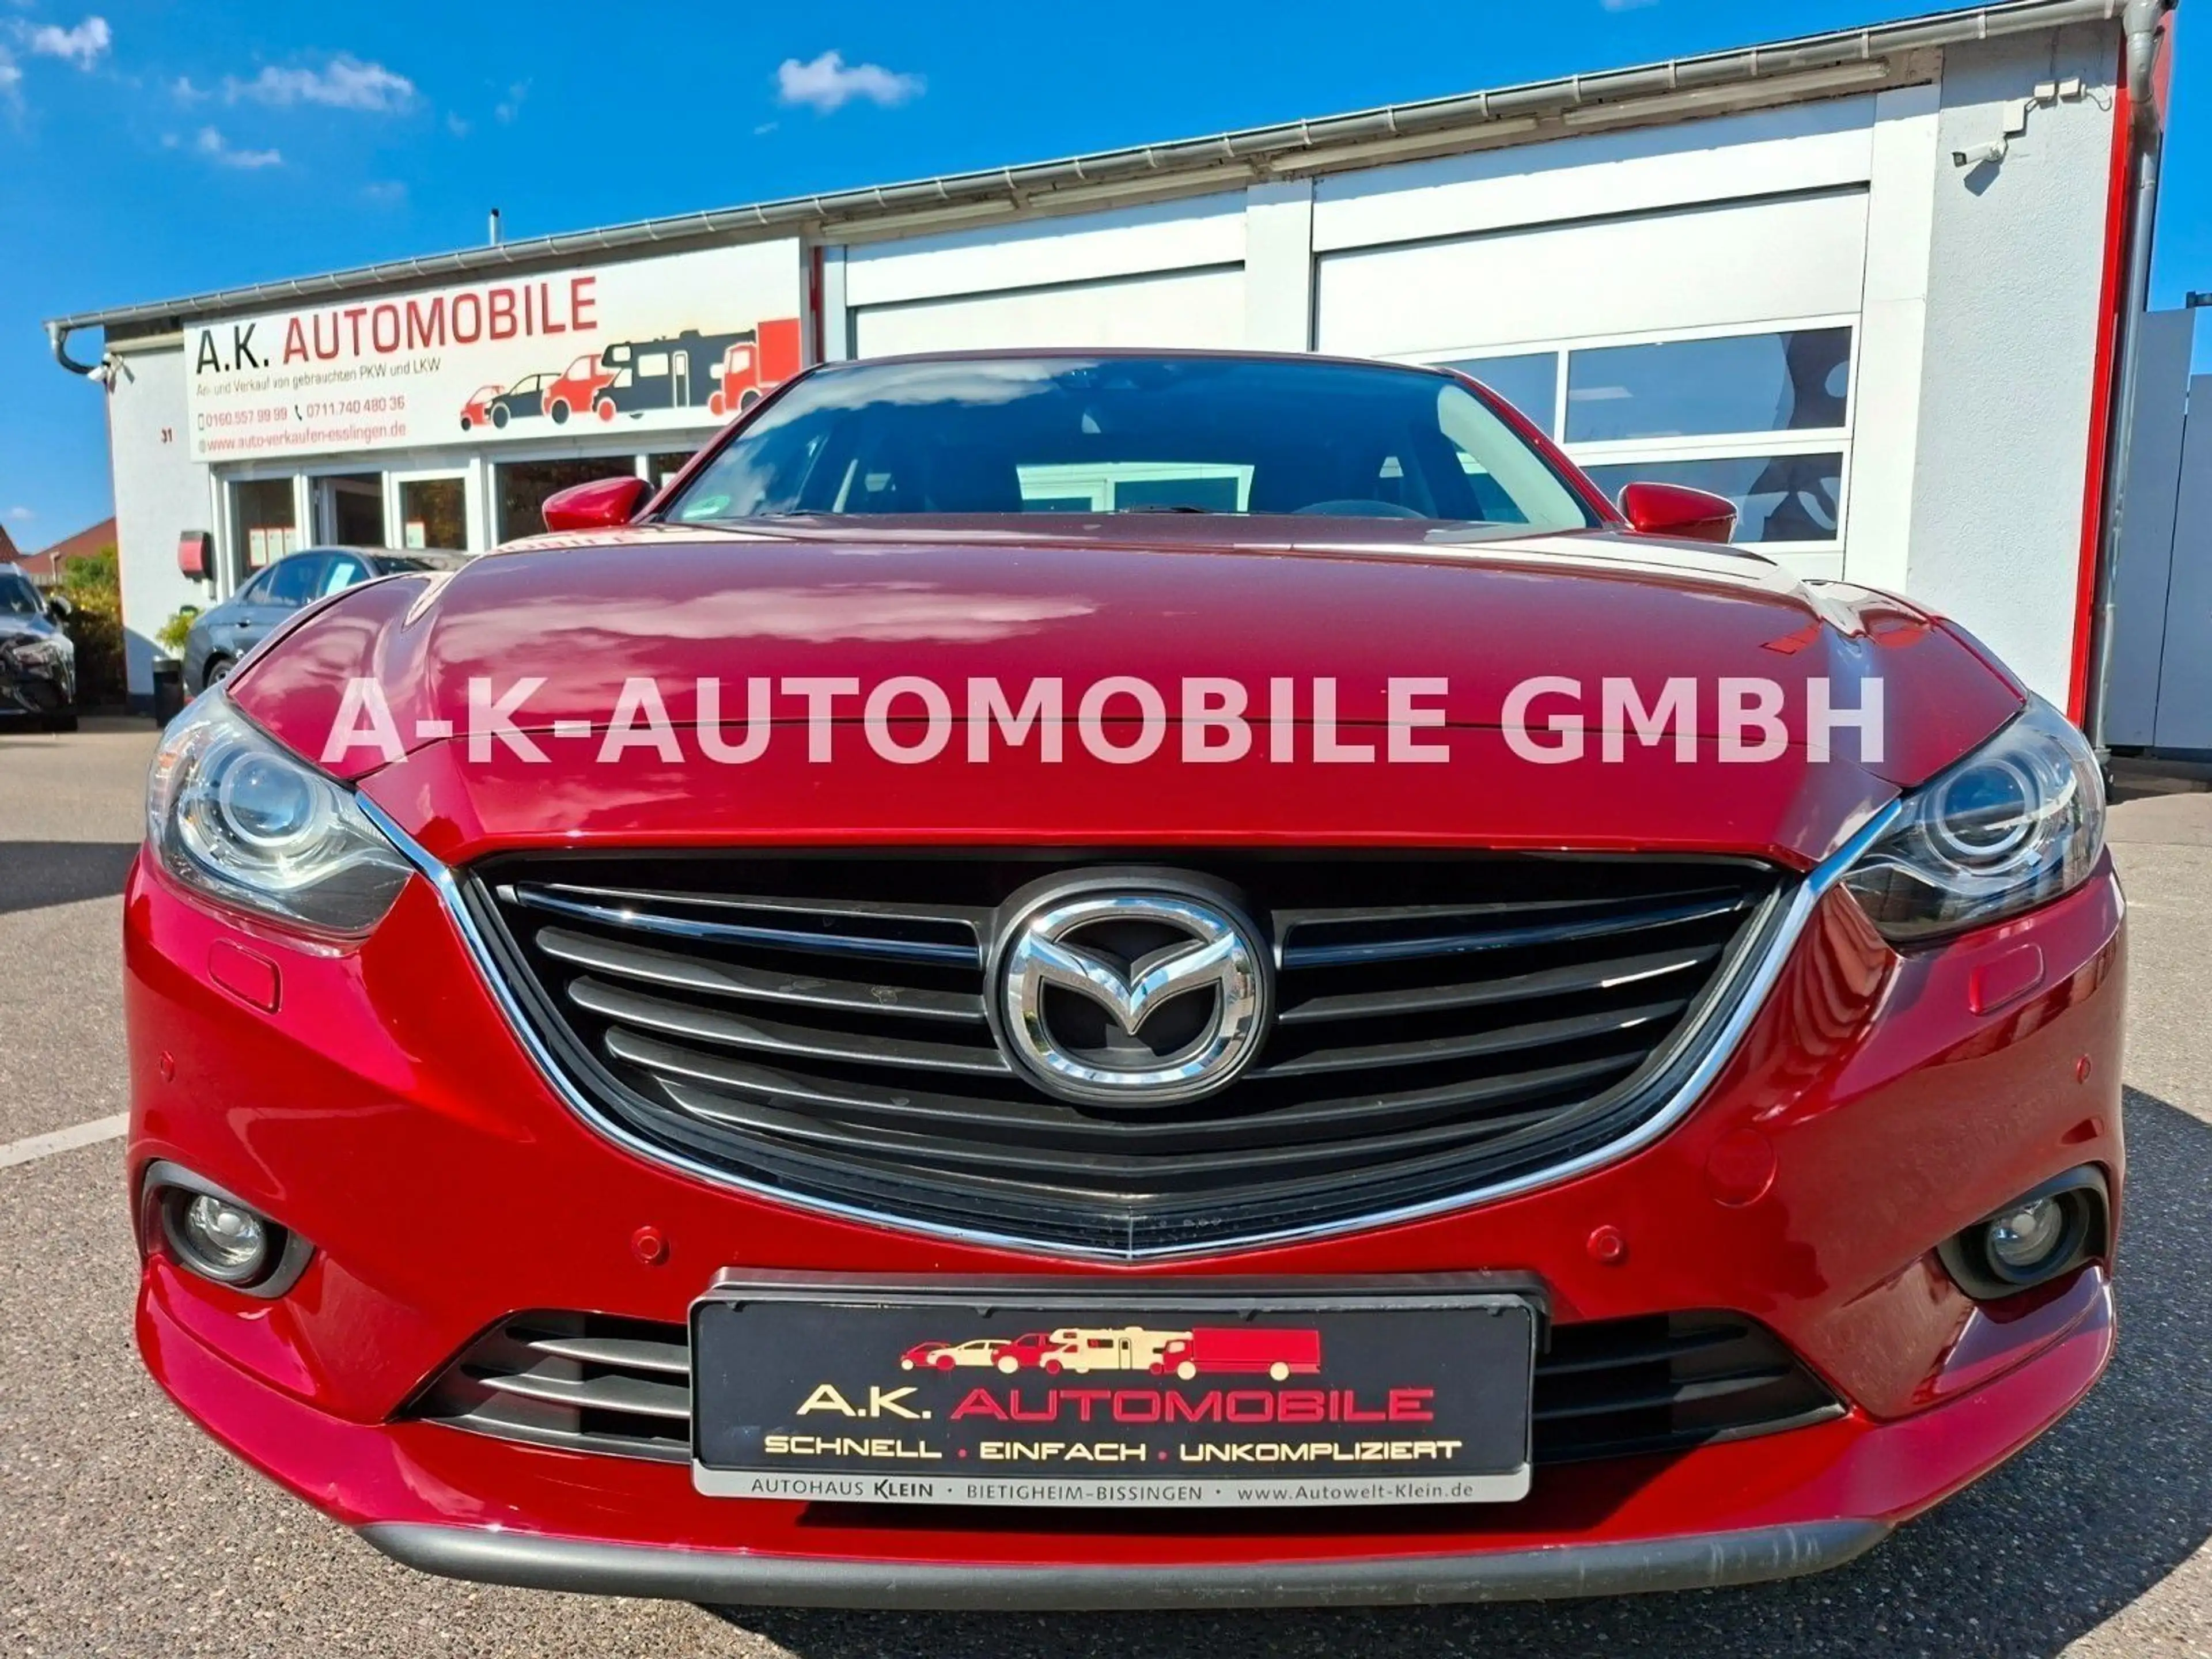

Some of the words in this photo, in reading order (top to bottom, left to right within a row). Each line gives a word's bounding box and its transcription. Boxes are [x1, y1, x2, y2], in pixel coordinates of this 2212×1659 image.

[196, 323, 270, 374] A.K.
[283, 276, 597, 365] AUTOMOBILE
[214, 382, 231, 395] und
[233, 376, 270, 393] Verkauf
[273, 378, 289, 389] von
[293, 370, 357, 390] gebrauchten
[359, 363, 387, 380] PKW
[389, 361, 410, 376] und
[413, 357, 441, 374] LKW
[207, 420, 406, 452] www.auto-verkaufen-esslingen.de
[796, 1384, 931, 1419] A.K.
[950, 1387, 1434, 1423] AUTOMOBILE
[764, 1435, 942, 1459] SCHNELL
[979, 1441, 1146, 1461] EINFACH
[1180, 1441, 1462, 1462] UNKOMPLIZIERT
[751, 1478, 864, 1495] AUTOHAUS
[873, 1478, 934, 1499] KLEIN
[967, 1484, 1202, 1501] BIETIGHEIM-BISSINGEN
[1237, 1482, 1474, 1500] www.Autowelt-Klein.de
